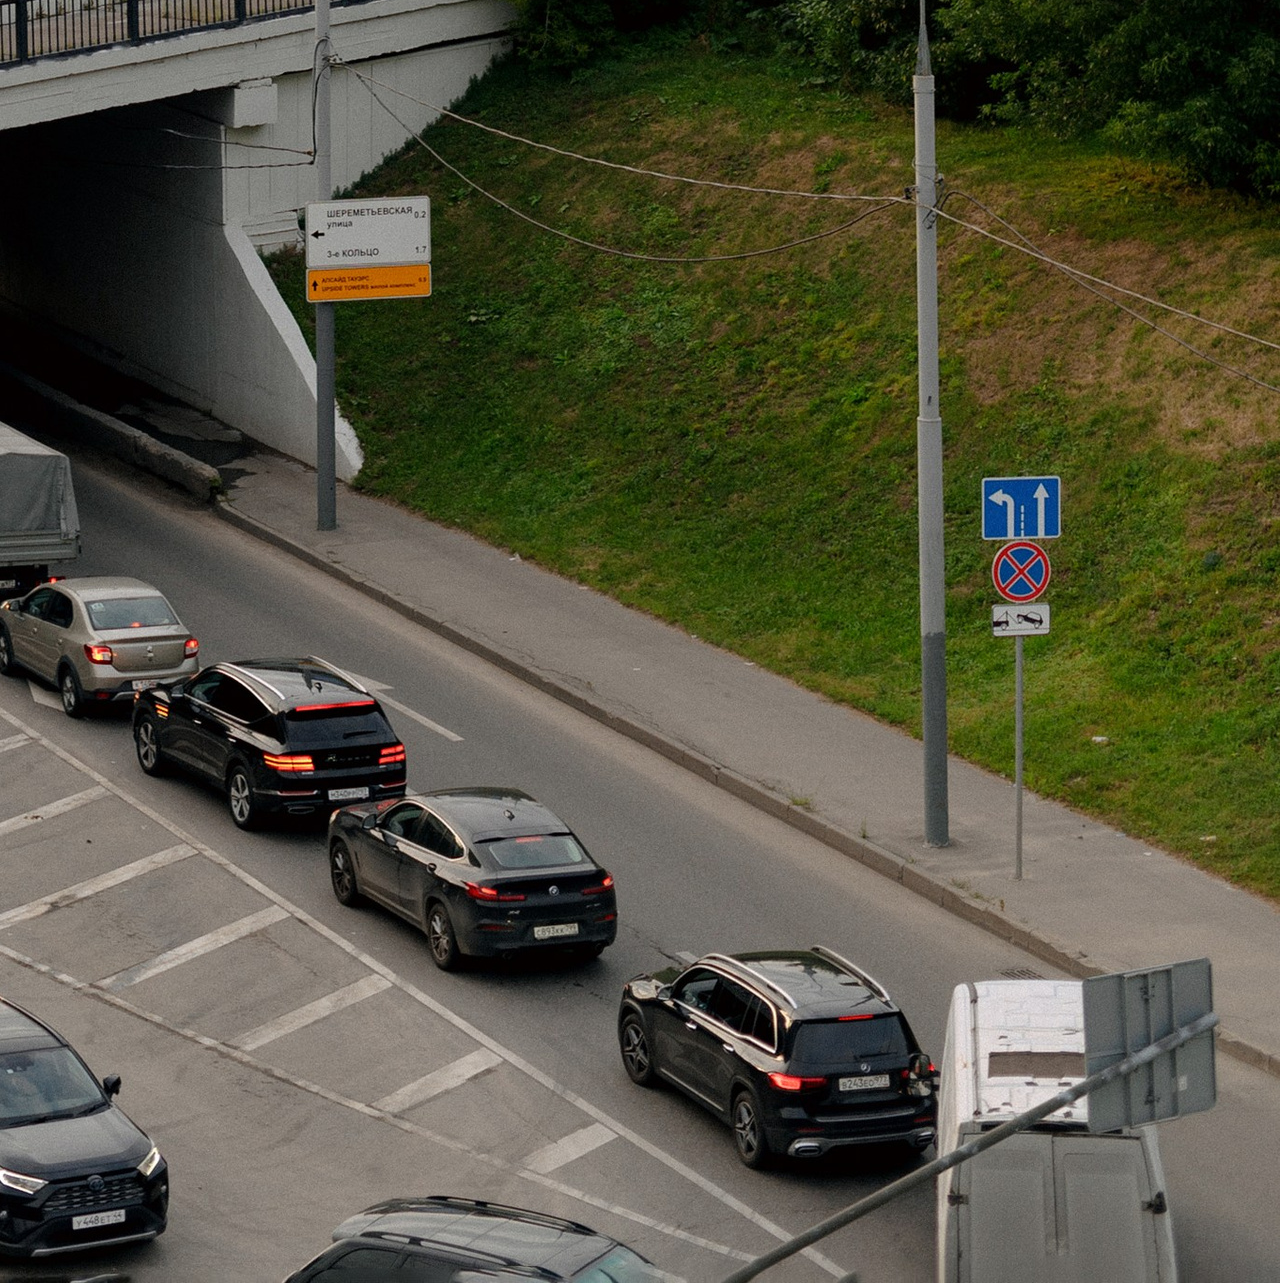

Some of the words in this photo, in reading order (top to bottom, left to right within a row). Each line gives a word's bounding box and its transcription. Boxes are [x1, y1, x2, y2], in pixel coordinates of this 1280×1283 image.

[326, 206, 413, 218] ШЕРЕМЕТЬЕВСКАЯ
[414, 210, 427, 219] 0.2
[326, 220, 353, 229] улица
[327, 250, 340, 258] 3-е
[342, 248, 379, 258] КОЛЬЦО
[415, 246, 427, 254] 1.7
